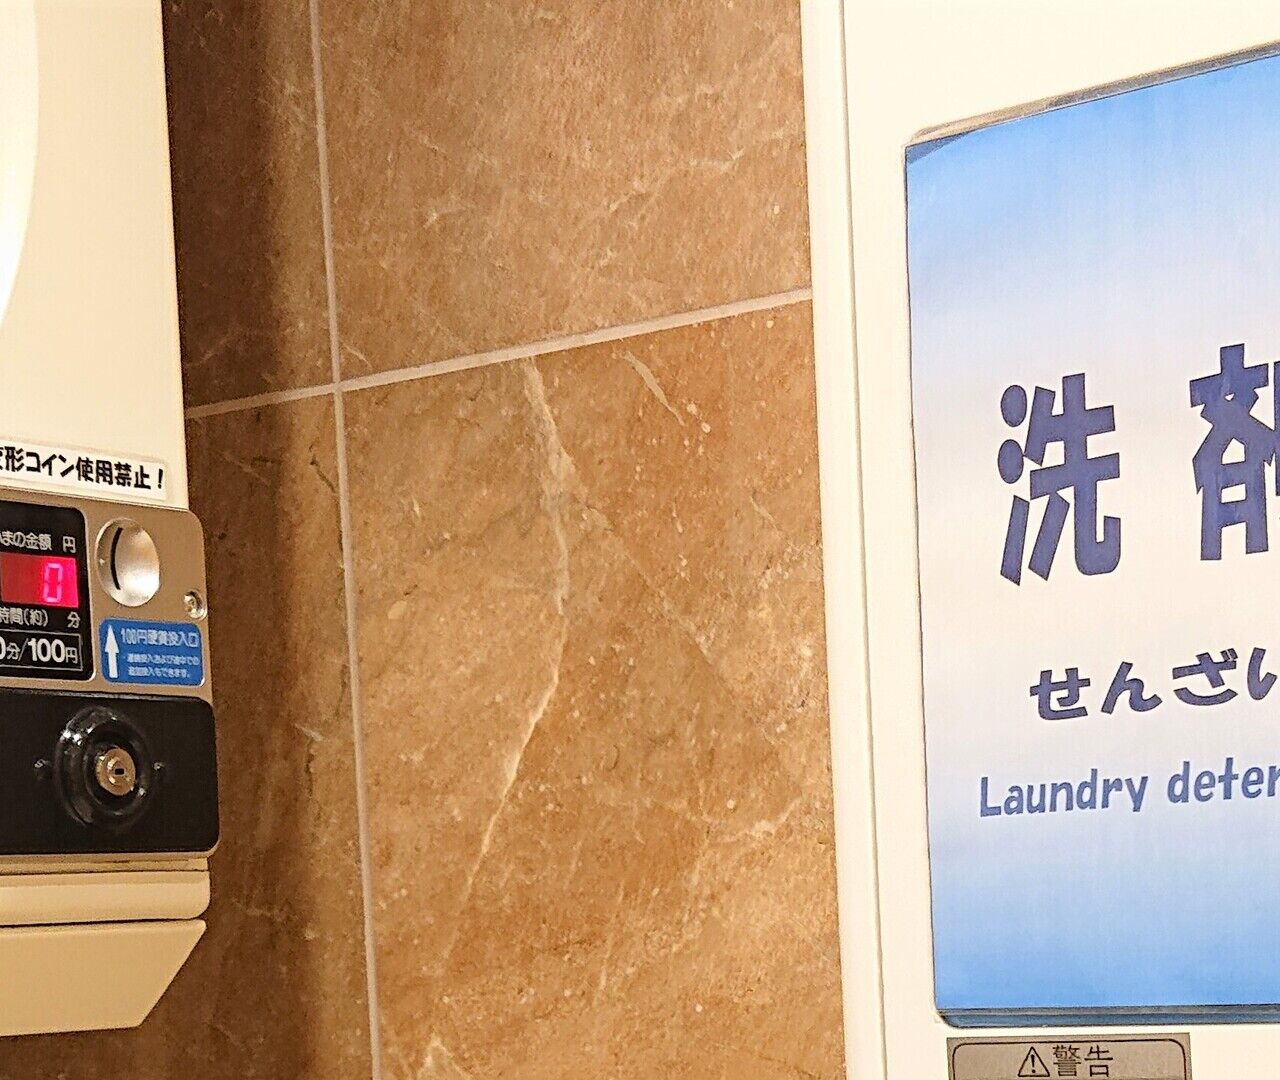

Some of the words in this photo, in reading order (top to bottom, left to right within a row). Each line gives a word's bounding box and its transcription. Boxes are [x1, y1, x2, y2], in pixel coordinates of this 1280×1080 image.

[62, 536, 76, 553] 円
[43, 562, 64, 603] 0
[67, 612, 80, 629] 分
[980, 768, 1148, 818] Laundry
[1052, 1045, 1113, 1077] 警告
